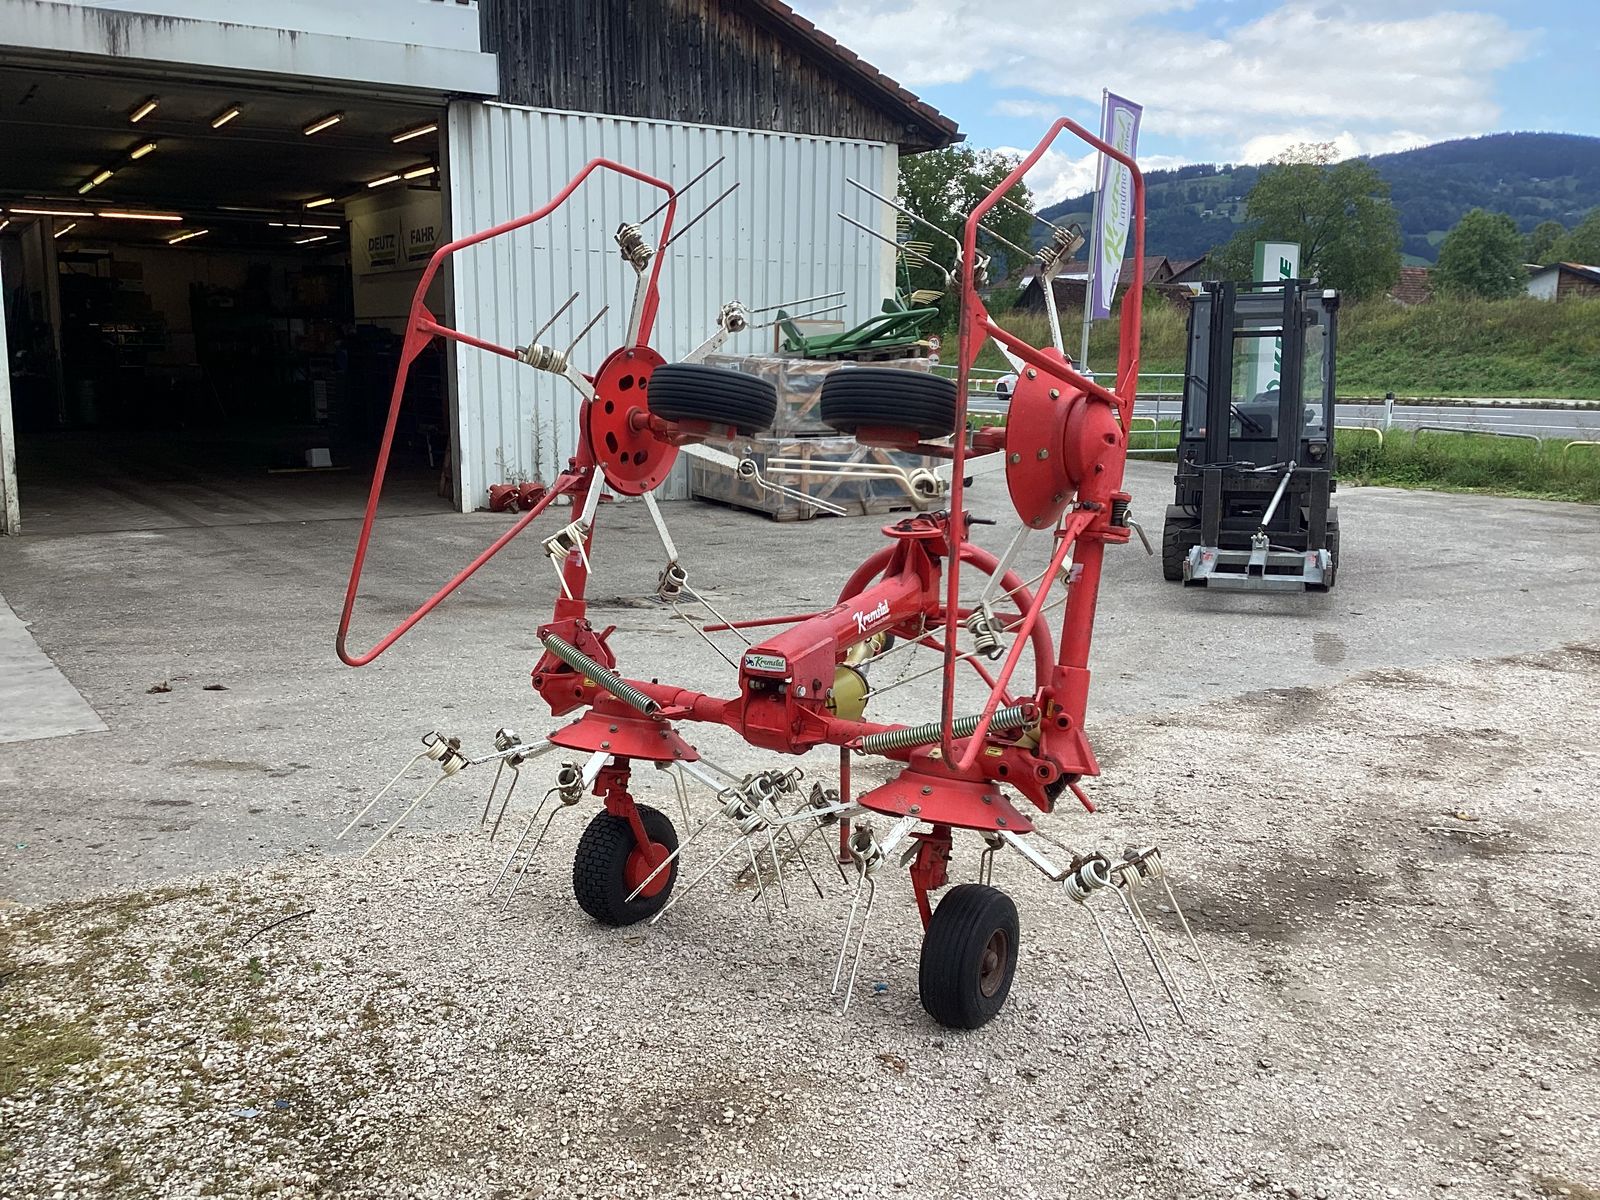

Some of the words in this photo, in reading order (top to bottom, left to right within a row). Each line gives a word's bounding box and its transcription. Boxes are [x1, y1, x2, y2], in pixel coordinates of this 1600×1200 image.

[368, 234, 395, 251] DEUTZ
[410, 226, 434, 244] FAHR
[754, 655, 785, 668] Kremstal
